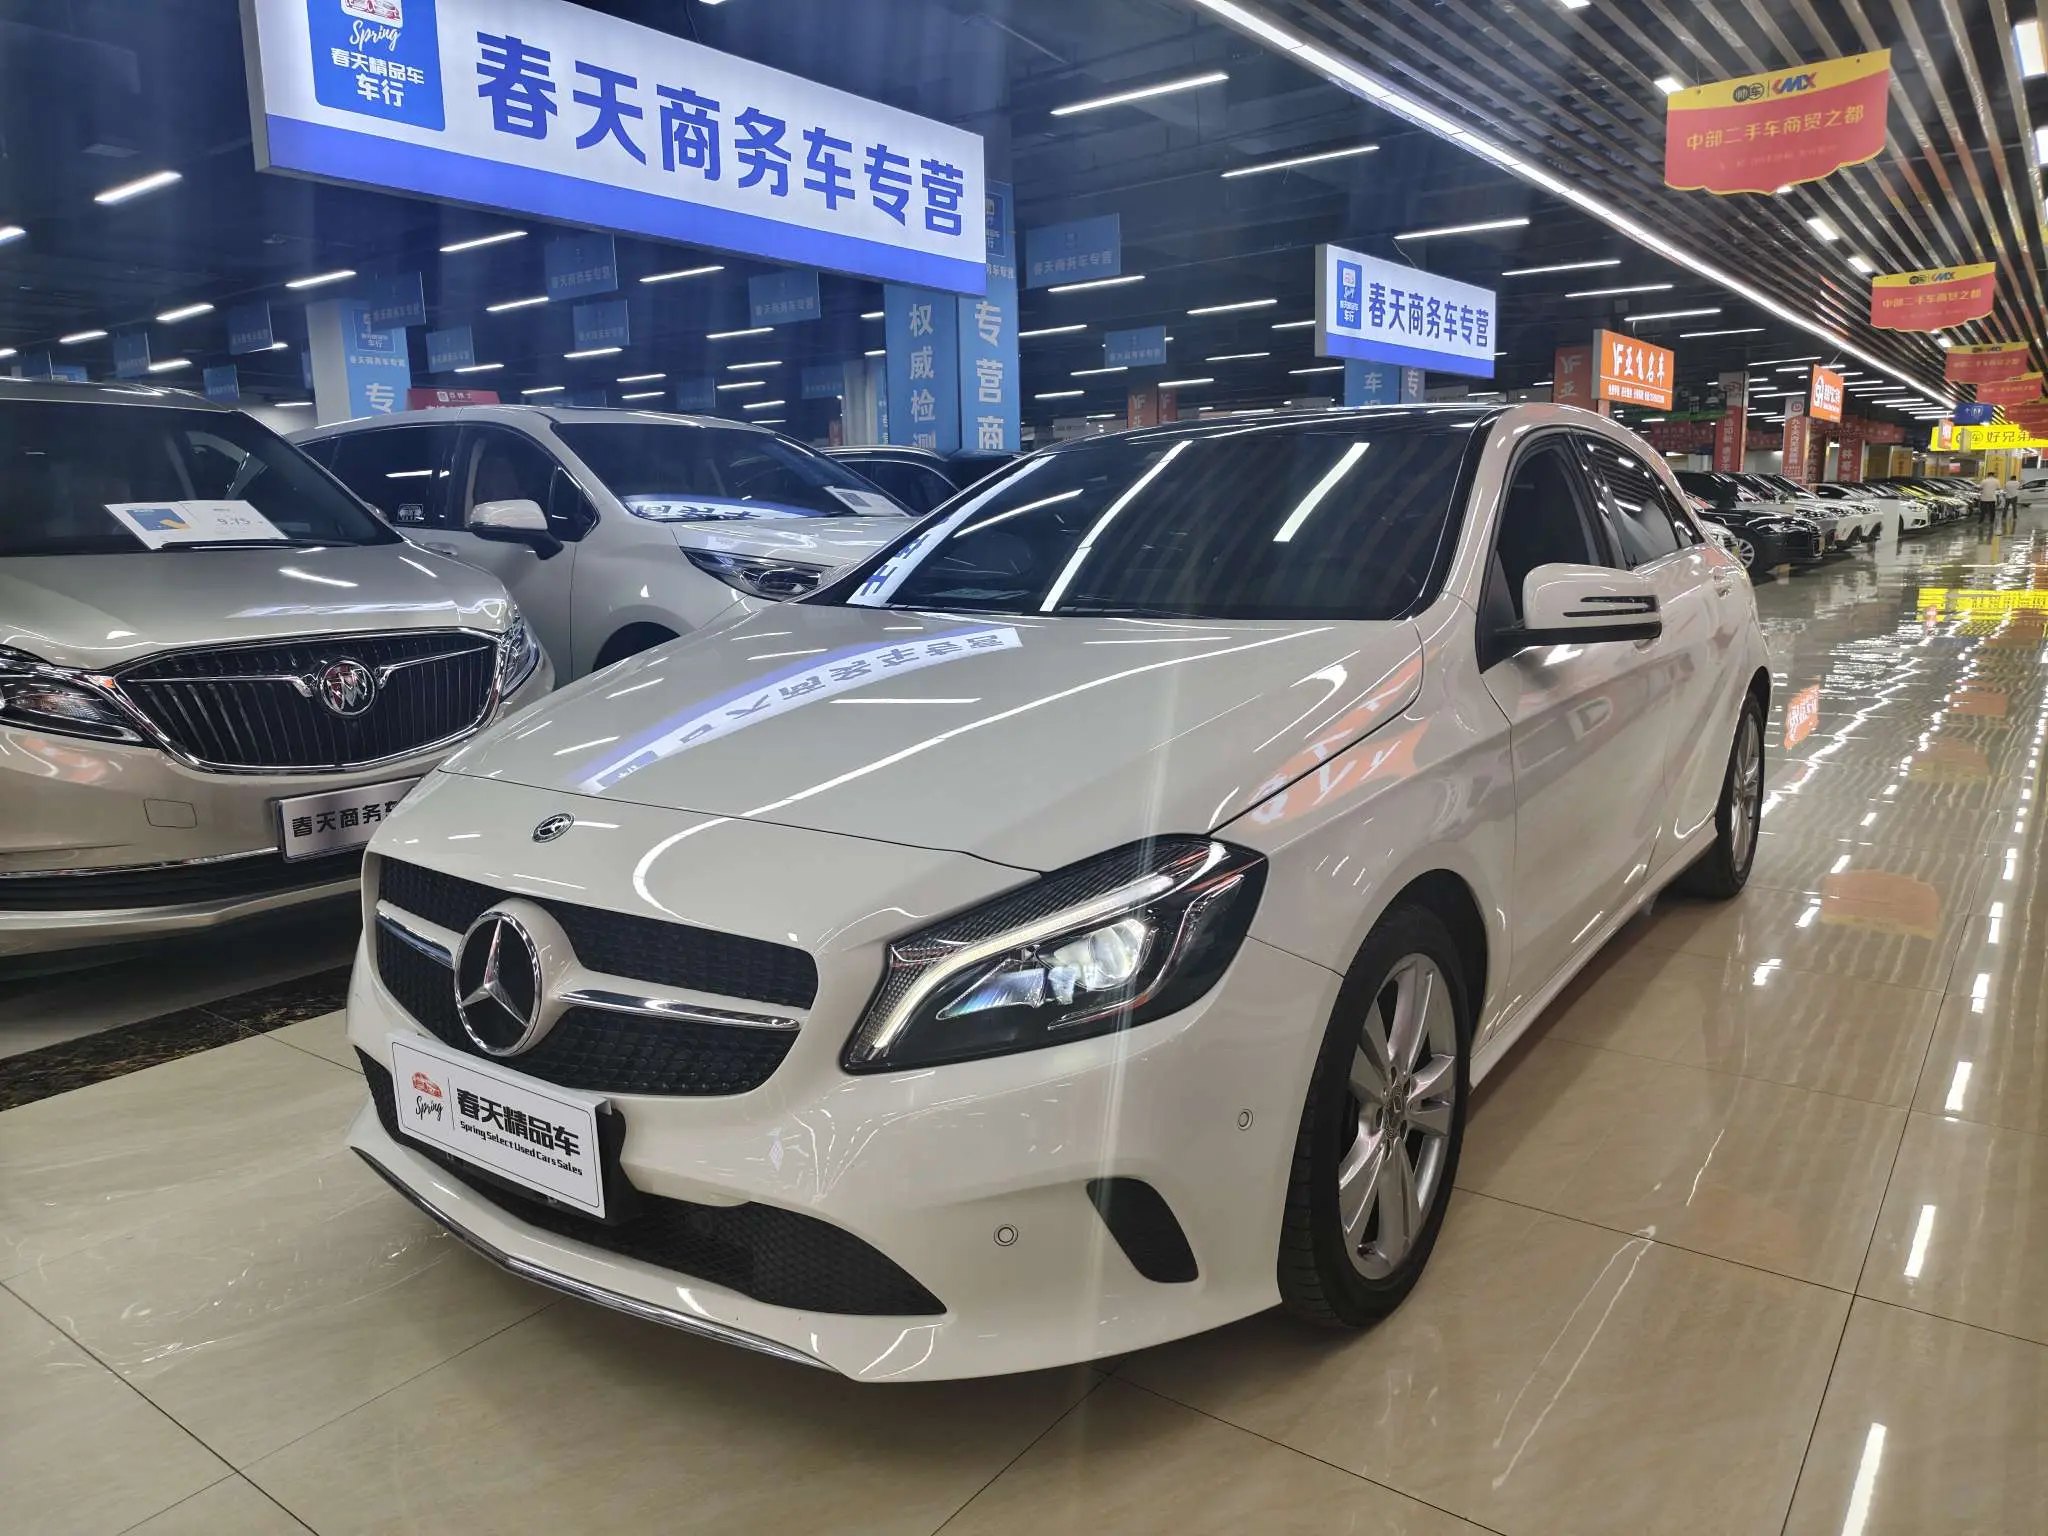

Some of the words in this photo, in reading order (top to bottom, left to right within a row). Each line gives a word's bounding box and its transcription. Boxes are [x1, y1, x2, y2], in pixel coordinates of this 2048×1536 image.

[349, 20, 401, 52] Spring
[331, 47, 424, 84] 春天精品车
[356, 73, 404, 107] 车行
[475, 30, 965, 237] 春天商务车专营
[1686, 104, 1864, 151] 中部二手车商贸之都
[1368, 282, 1489, 347] 春天商务车专营
[415, 1096, 443, 1121] Spring
[457, 1087, 580, 1157] 春天精品车
[460, 1121, 487, 1141] Spring
[486, 1131, 513, 1149] Select
[514, 1142, 535, 1157] Used
[536, 1151, 557, 1166] Cars
[556, 1159, 583, 1176] Sales
